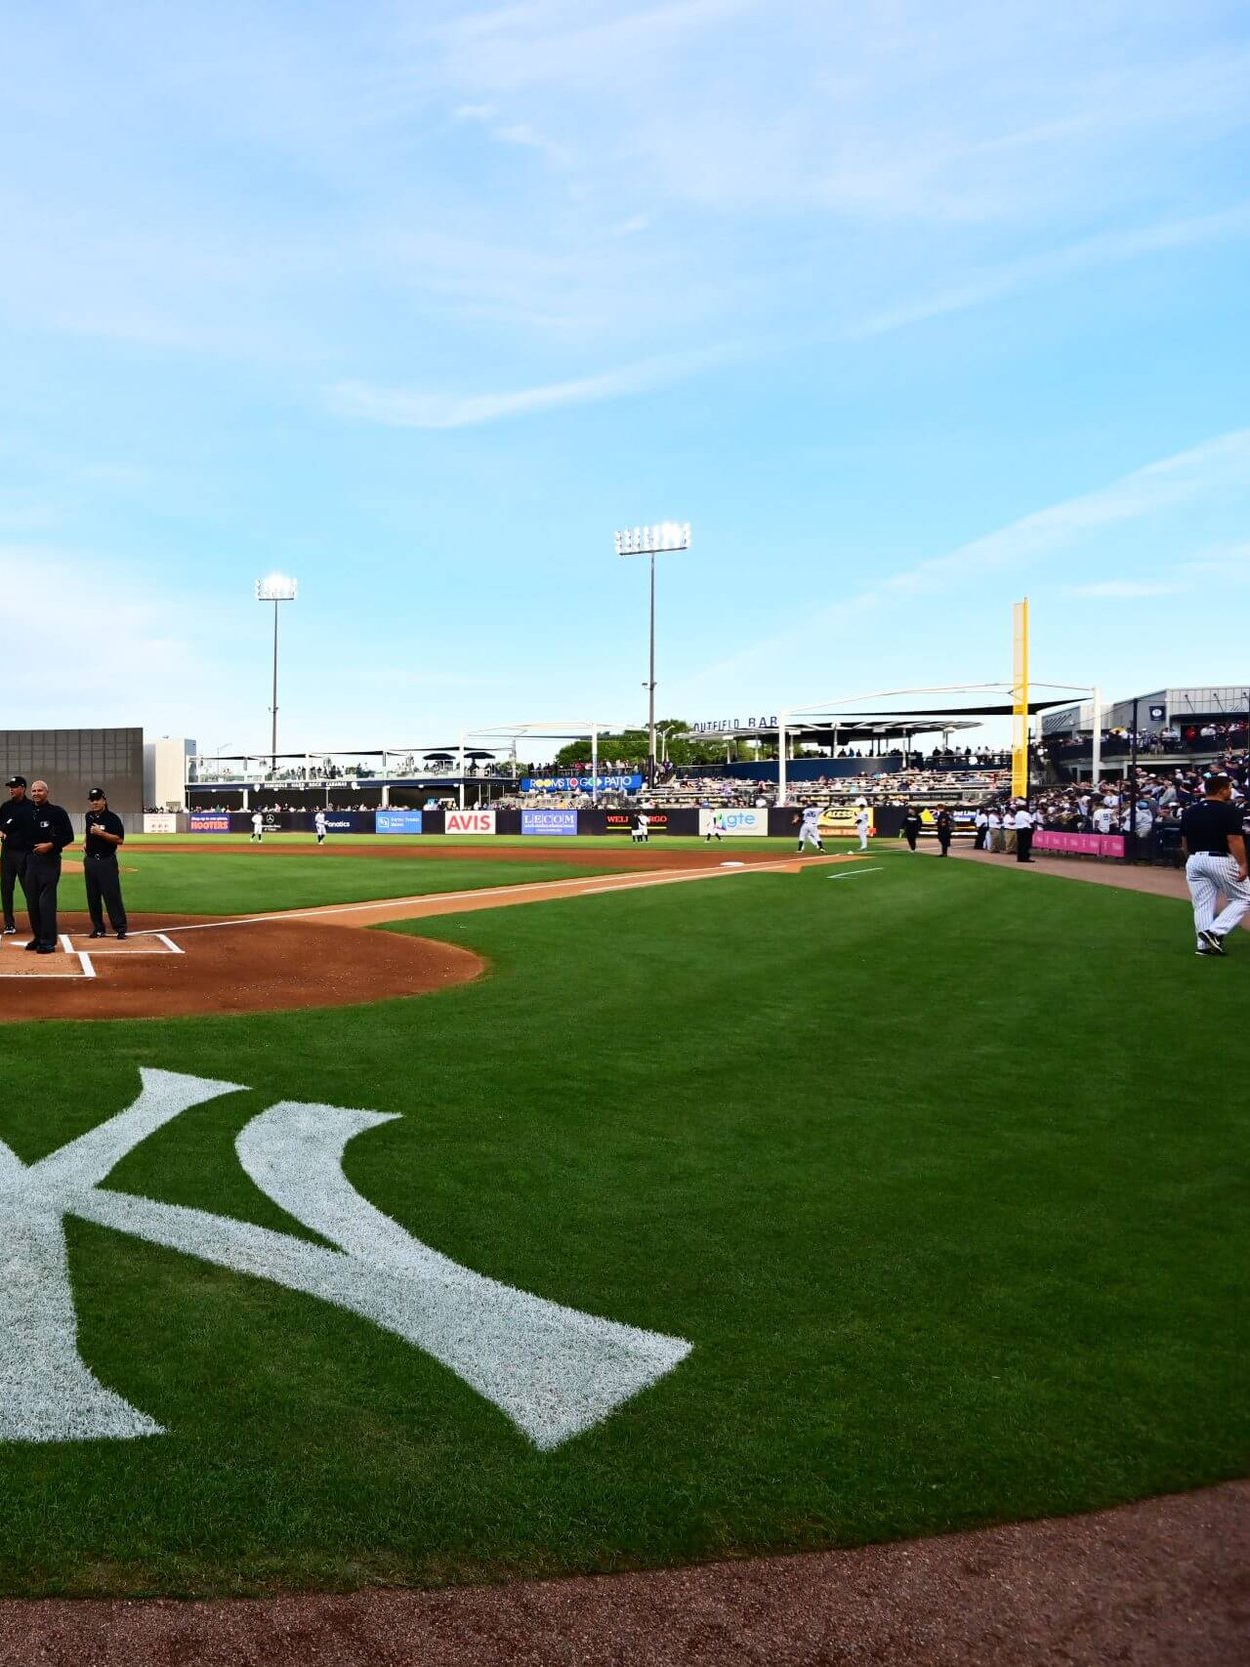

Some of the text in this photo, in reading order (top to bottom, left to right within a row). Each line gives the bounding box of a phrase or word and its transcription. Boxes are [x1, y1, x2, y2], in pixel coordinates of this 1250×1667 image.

[693, 716, 778, 732] OUTFIELD BAR
[530, 779, 565, 789] ROOMS
[566, 778, 579, 788] TO
[604, 775, 632, 788] PATIO
[191, 821, 228, 829] HOOTERS
[447, 815, 491, 830] AVIS
[524, 814, 574, 824] LECOM
[727, 812, 755, 828] gte
